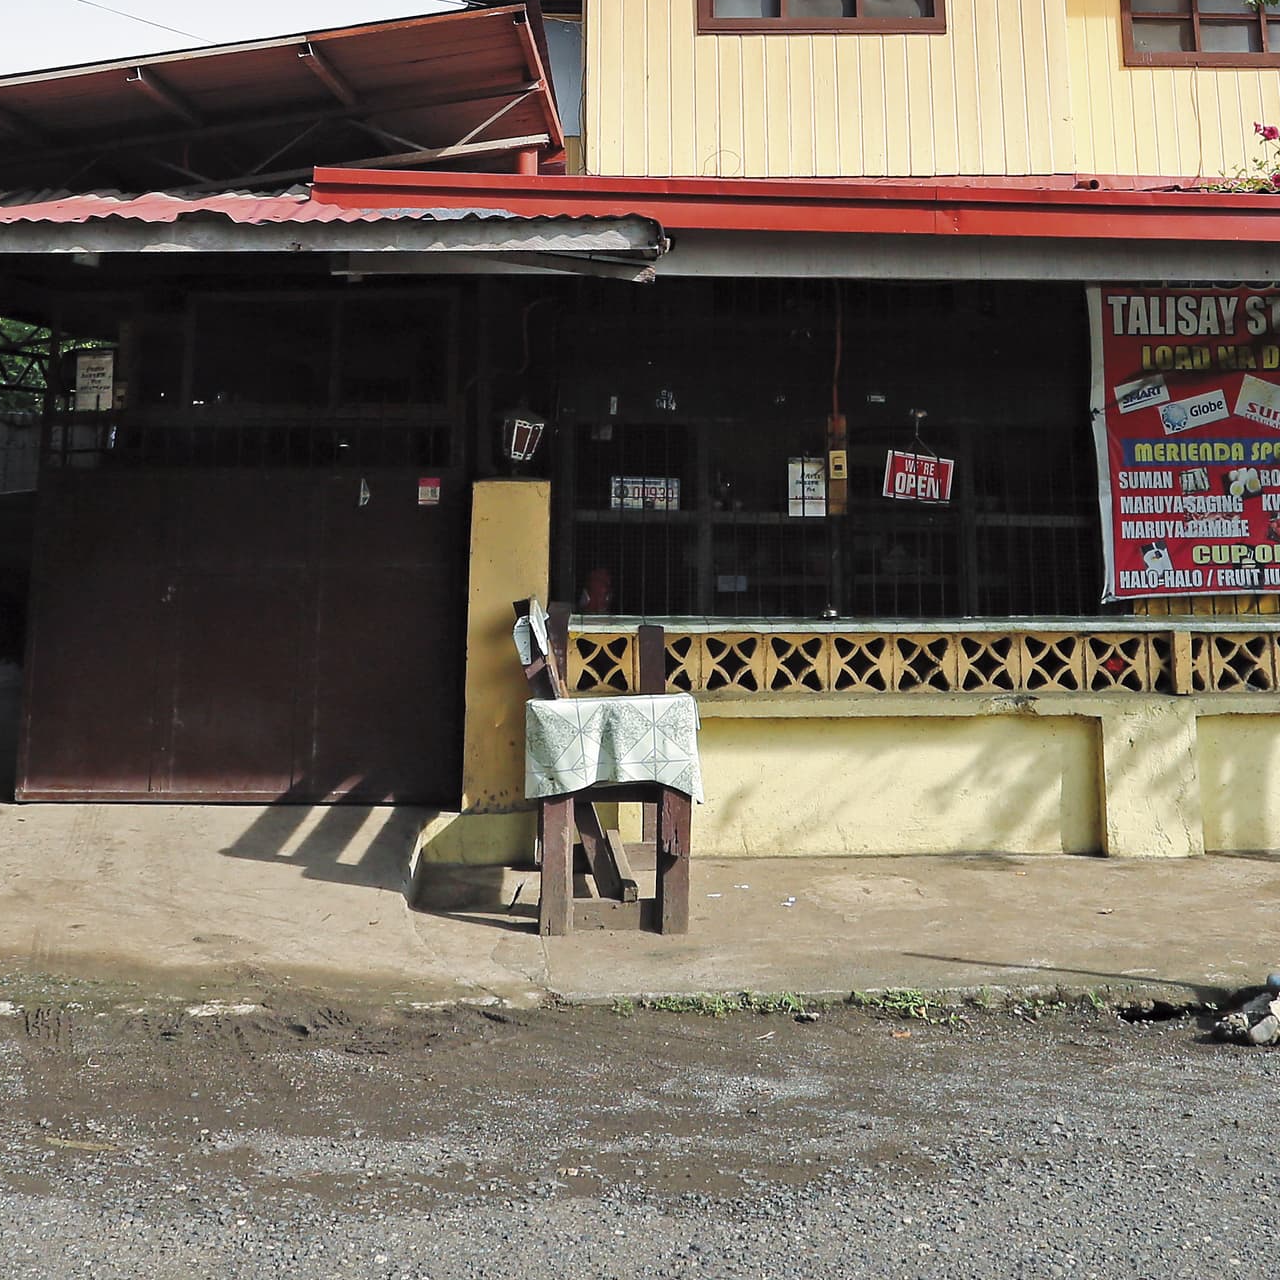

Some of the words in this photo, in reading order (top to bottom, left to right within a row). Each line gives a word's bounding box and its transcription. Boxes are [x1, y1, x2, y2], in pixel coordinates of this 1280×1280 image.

[1107, 295, 1238, 335] TALISAY
[1142, 346, 1211, 369] LOAD
[1217, 346, 1257, 369] NA
[1122, 385, 1162, 404] SMART
[1190, 400, 1223, 417] Globe
[1134, 442, 1244, 462] MERIENDA
[895, 472, 942, 499] OPEN
[1119, 471, 1173, 489] SUMAN
[1192, 545, 1248, 564] CUP
[1217, 568, 1261, 586] FRUIT
